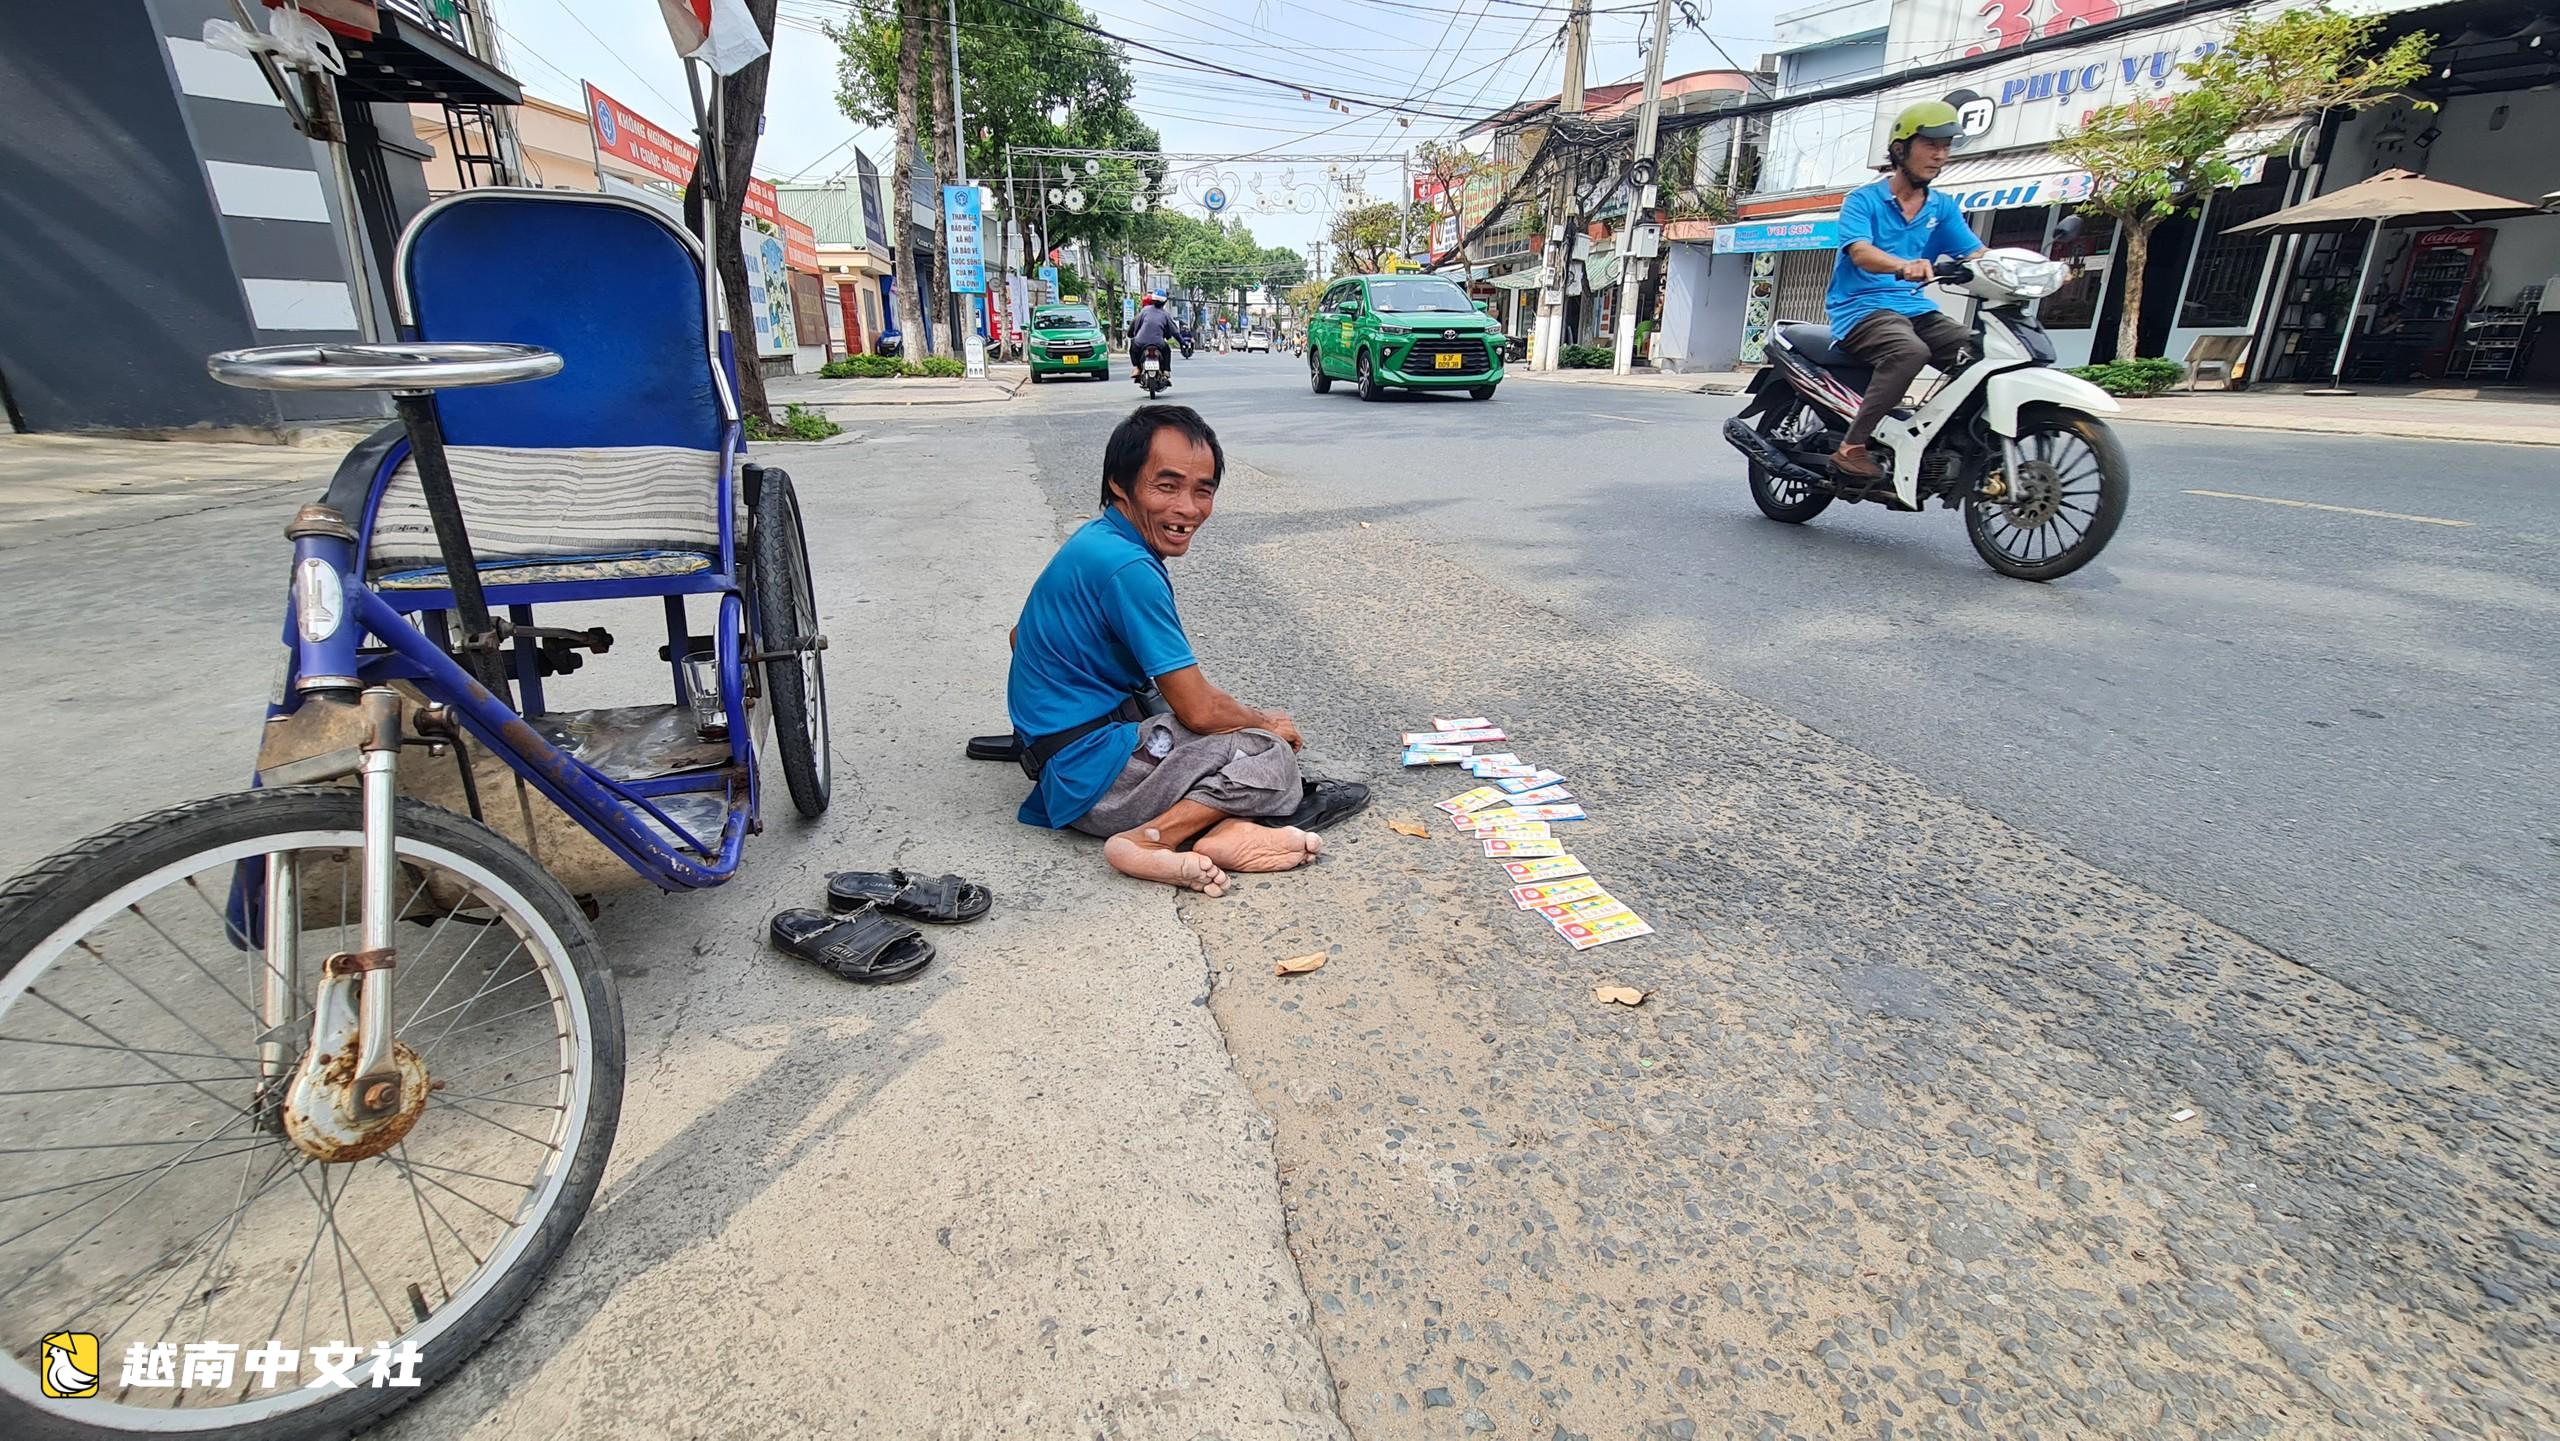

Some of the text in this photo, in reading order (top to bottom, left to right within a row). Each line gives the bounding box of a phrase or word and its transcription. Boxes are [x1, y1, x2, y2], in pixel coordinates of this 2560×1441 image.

[2000, 59, 2108, 106] PHỤC
[2120, 47, 2180, 88] VỤ
[616, 110, 646, 139] KHÔNG
[1961, 108, 1986, 130] Fi
